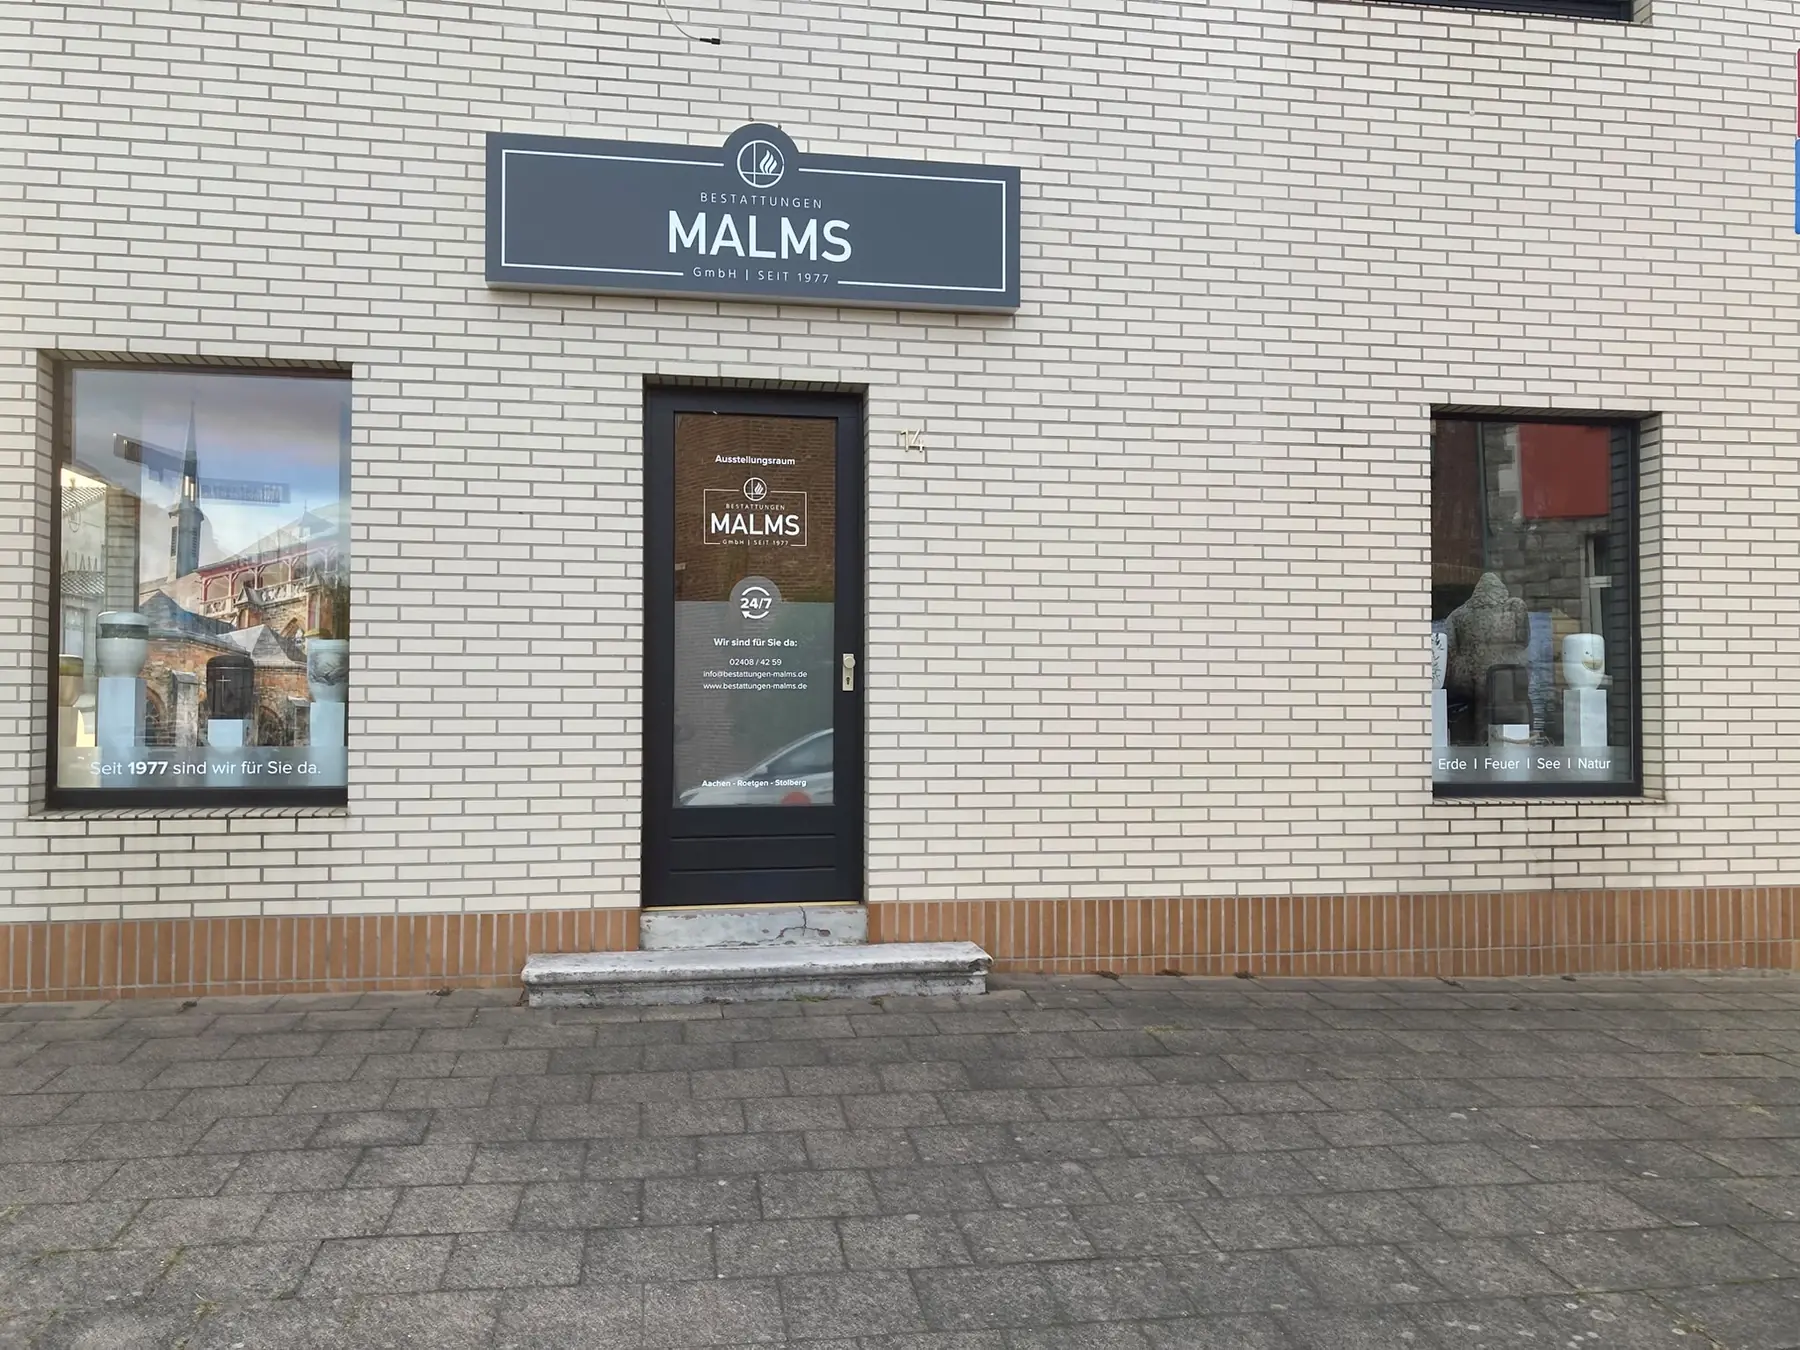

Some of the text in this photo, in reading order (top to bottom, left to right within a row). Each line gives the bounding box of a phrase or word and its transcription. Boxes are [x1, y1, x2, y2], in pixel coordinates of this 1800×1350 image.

[700, 192, 823, 209] BESTATTUNGEN
[668, 210, 852, 263] MALMS
[693, 267, 737, 279] GmbH
[757, 270, 789, 281] SEIT
[797, 272, 829, 284] 1977
[900, 428, 925, 453] 14
[715, 454, 796, 466] Ausstellungsraum
[725, 503, 785, 511] BESTATTUNGEN
[711, 512, 800, 536] MALMS
[740, 597, 772, 610] 24/7
[713, 638, 798, 647] Wir sind für Sie da:
[729, 658, 754, 666] 02408
[760, 658, 770, 666] 42
[771, 658, 782, 666] 59
[703, 670, 808, 679] info@bestattungen-malms.de
[703, 682, 808, 691] www.bestattungen-malms.de
[90, 760, 322, 776] Seit 1977 sind wir für Sie da.
[1438, 758, 1467, 770] Erde
[1484, 758, 1520, 770] Feuer
[1537, 757, 1561, 770] See
[1578, 757, 1611, 770] Natur
[737, 780, 769, 788] Roetgen
[775, 779, 807, 787] Stolberg
